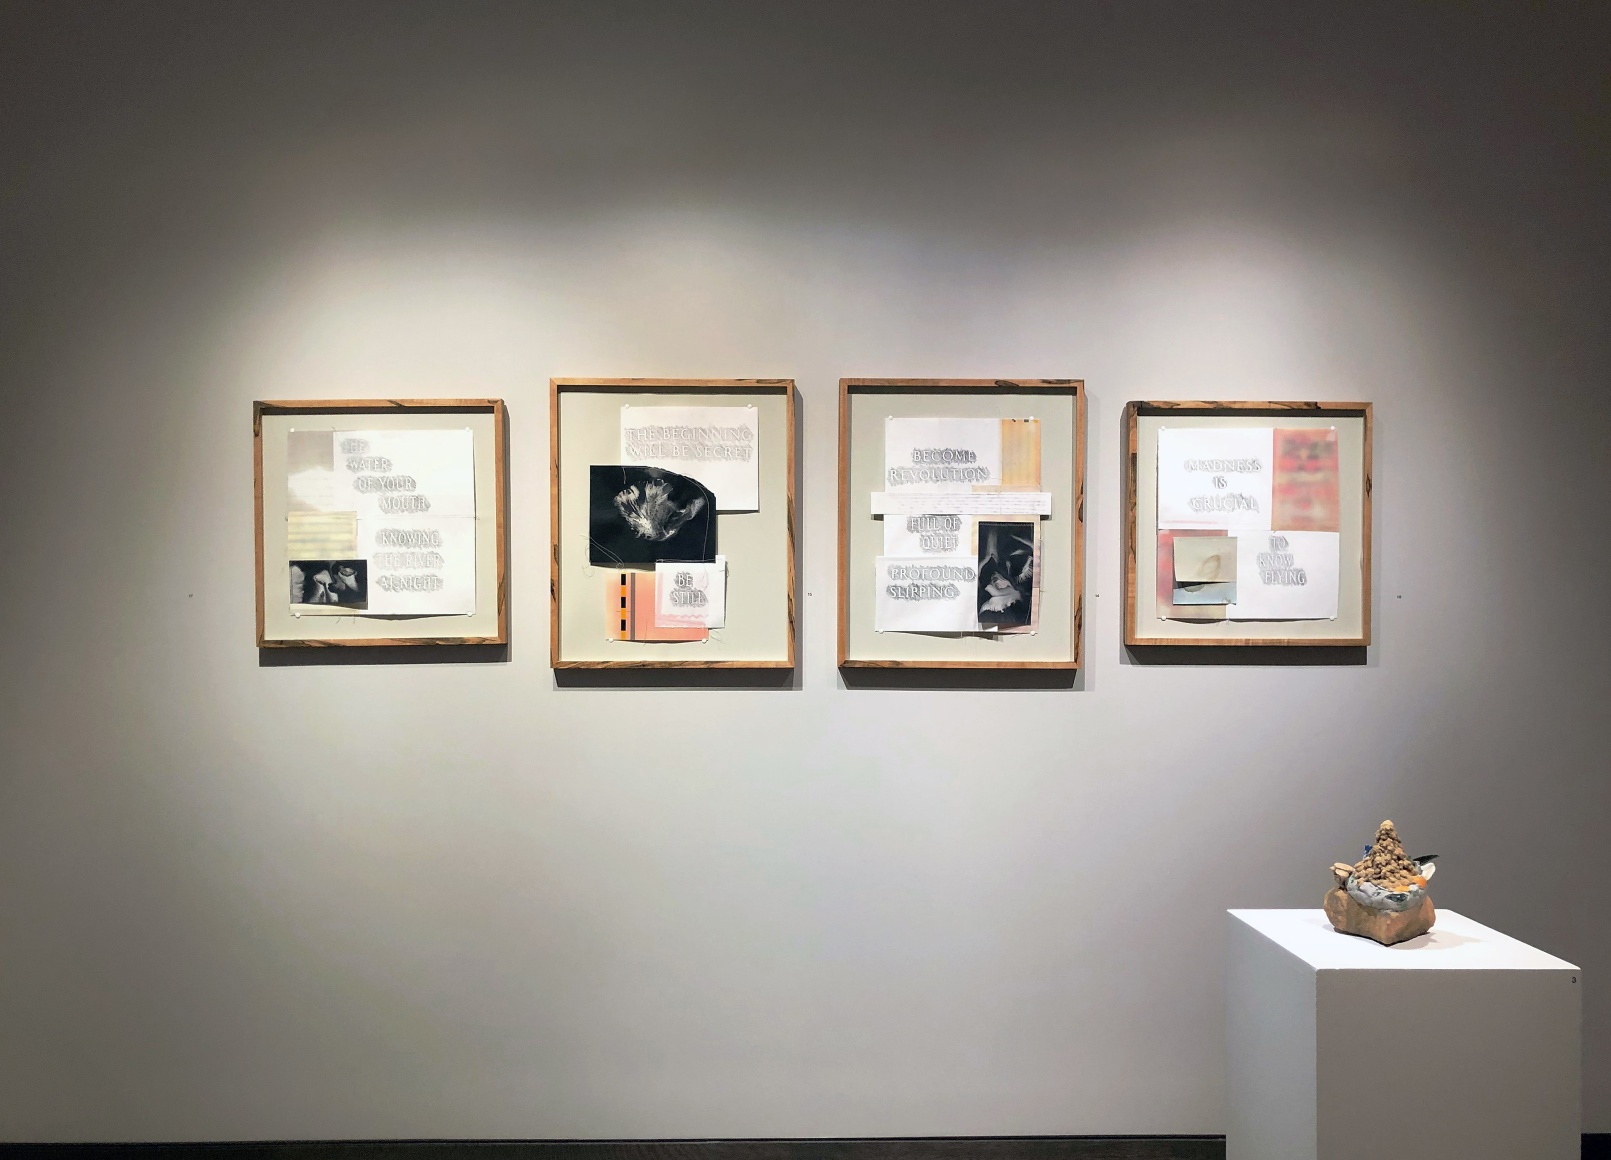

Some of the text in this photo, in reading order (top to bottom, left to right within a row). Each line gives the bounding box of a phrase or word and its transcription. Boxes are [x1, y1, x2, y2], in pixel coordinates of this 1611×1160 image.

[627, 427, 752, 441] THE BEGINNING
[628, 445, 752, 458] WILL BE SECRET
[913, 450, 975, 462] BECOME
[350, 459, 389, 471] WATER
[1187, 459, 1262, 472] MADNESS
[889, 468, 989, 481] REVOLUTION
[358, 477, 412, 491] OF YOUR
[1214, 477, 1227, 489] IS
[382, 497, 427, 510] MOUTH
[1193, 498, 1255, 510] CRUCIAL
[911, 517, 960, 531] FULL OF
[382, 532, 440, 546] KNOWING
[922, 536, 958, 550] QUIET
[1271, 537, 1287, 549] TO
[376, 553, 443, 567] THE RIVER
[1259, 555, 1294, 567] KNOW
[677, 574, 694, 587] BE
[891, 568, 976, 581] PROFOUND
[1265, 571, 1306, 584] FLYING
[400, 576, 439, 589] NIGHT
[672, 591, 704, 604] STILL
[890, 586, 954, 598] SLIPPING
[1571, 976, 1577, 984] 3
